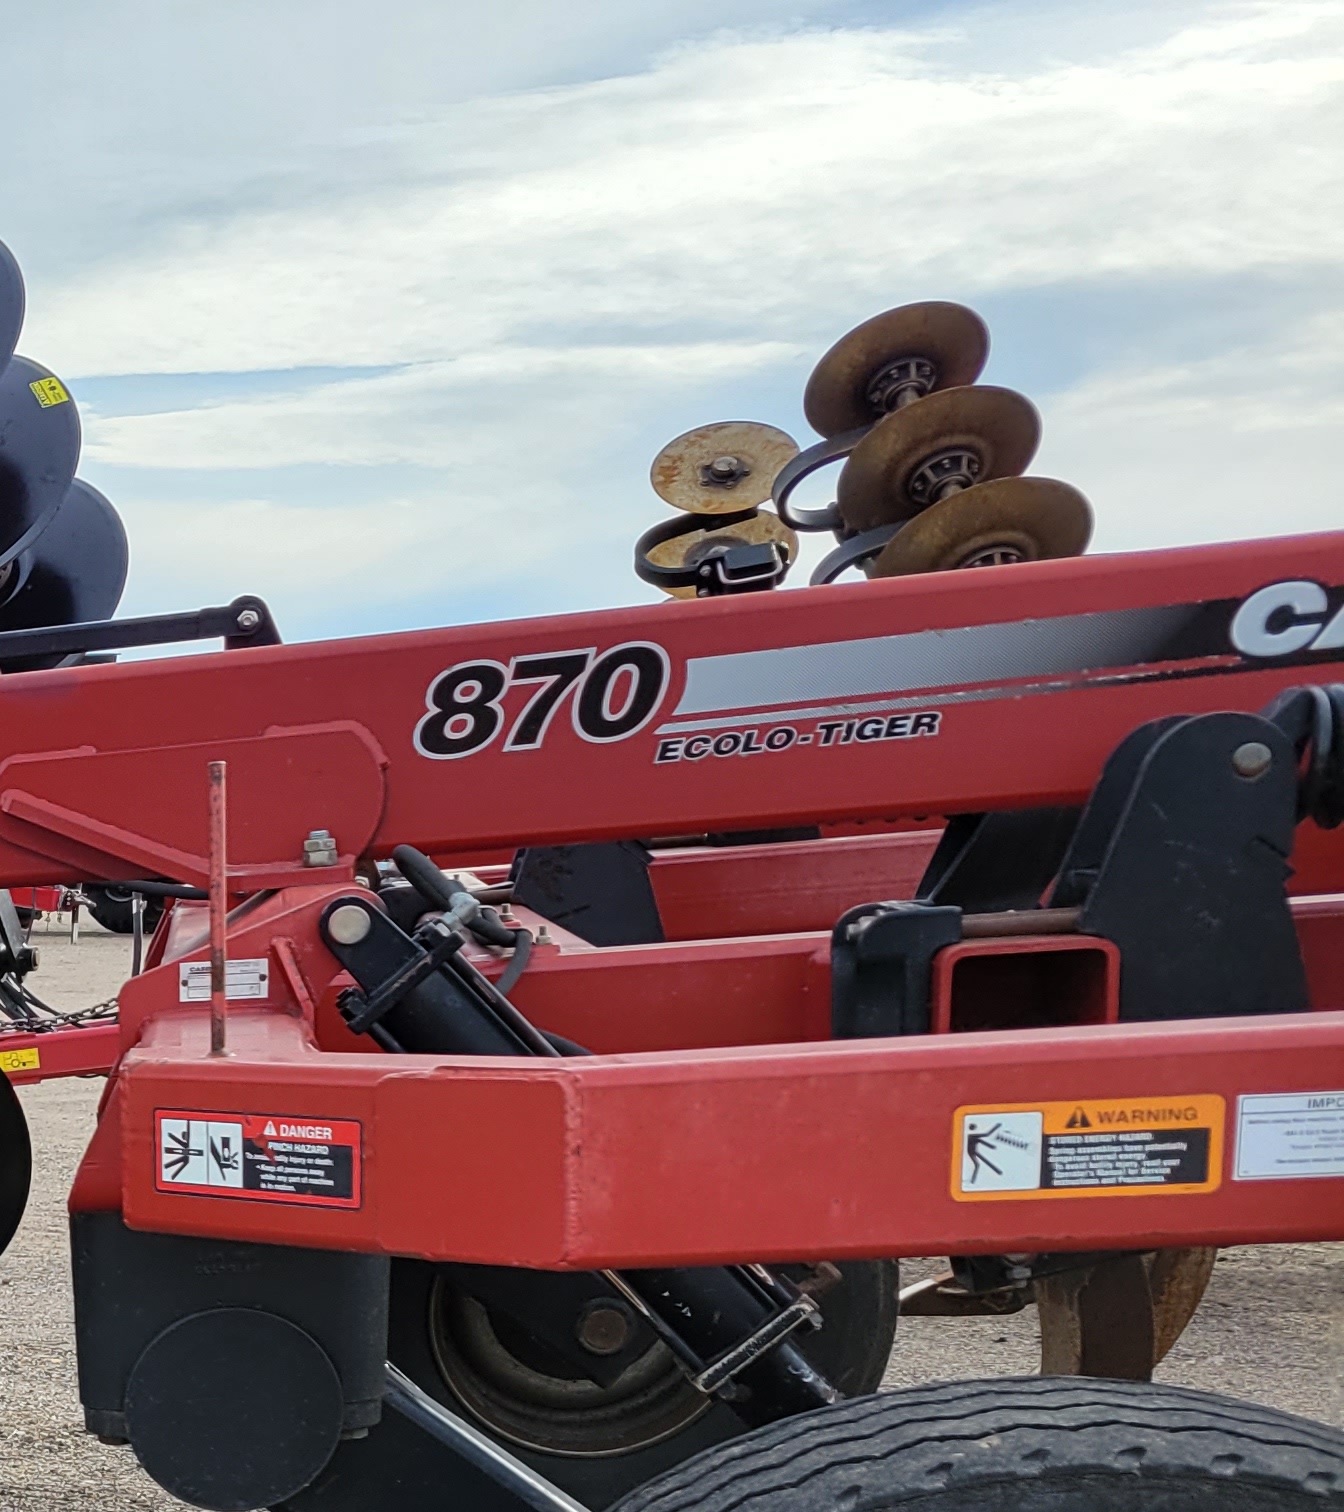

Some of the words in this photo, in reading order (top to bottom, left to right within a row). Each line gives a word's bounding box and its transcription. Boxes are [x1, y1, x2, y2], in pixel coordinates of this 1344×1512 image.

[412, 640, 671, 761] 870
[654, 711, 943, 764] ECOLO-TIGER
[1097, 1107, 1198, 1124] WARNING
[279, 1124, 332, 1140] DANGER
[294, 1143, 329, 1155] HAZARD
